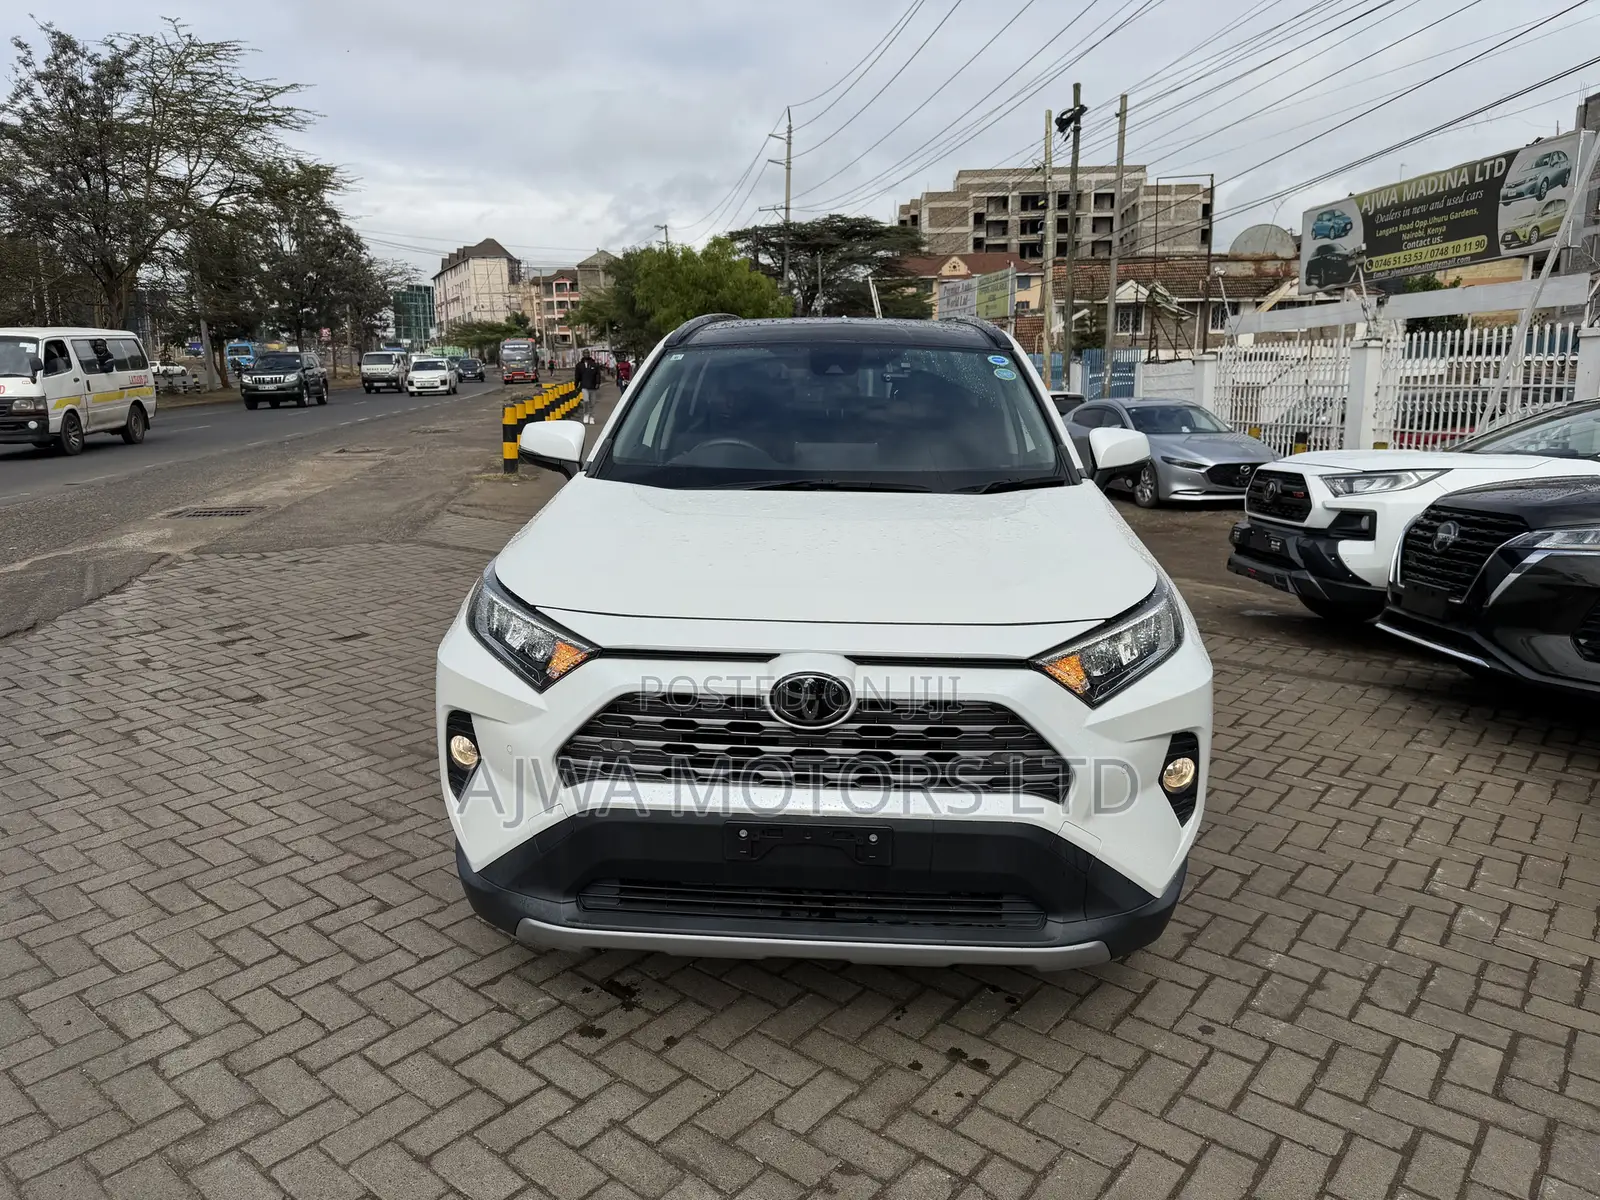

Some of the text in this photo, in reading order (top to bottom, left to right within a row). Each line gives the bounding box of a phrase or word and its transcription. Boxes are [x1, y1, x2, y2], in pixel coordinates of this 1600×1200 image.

[1361, 157, 1507, 216] AJWA MADINA LTD
[1374, 189, 1484, 224] Dealers in new and used cars
[1399, 220, 1415, 231] Road
[1426, 226, 1447, 236] Kenya
[1402, 235, 1443, 250] Contact us:
[1374, 258, 1392, 269] 0746
[1392, 256, 1402, 266] 51
[1402, 253, 1412, 264] 53
[1413, 251, 1423, 261] 53
[1430, 246, 1449, 259] 0748
[1451, 243, 1461, 254] 10
[1463, 241, 1473, 252] 11
[1475, 239, 1486, 250] 90
